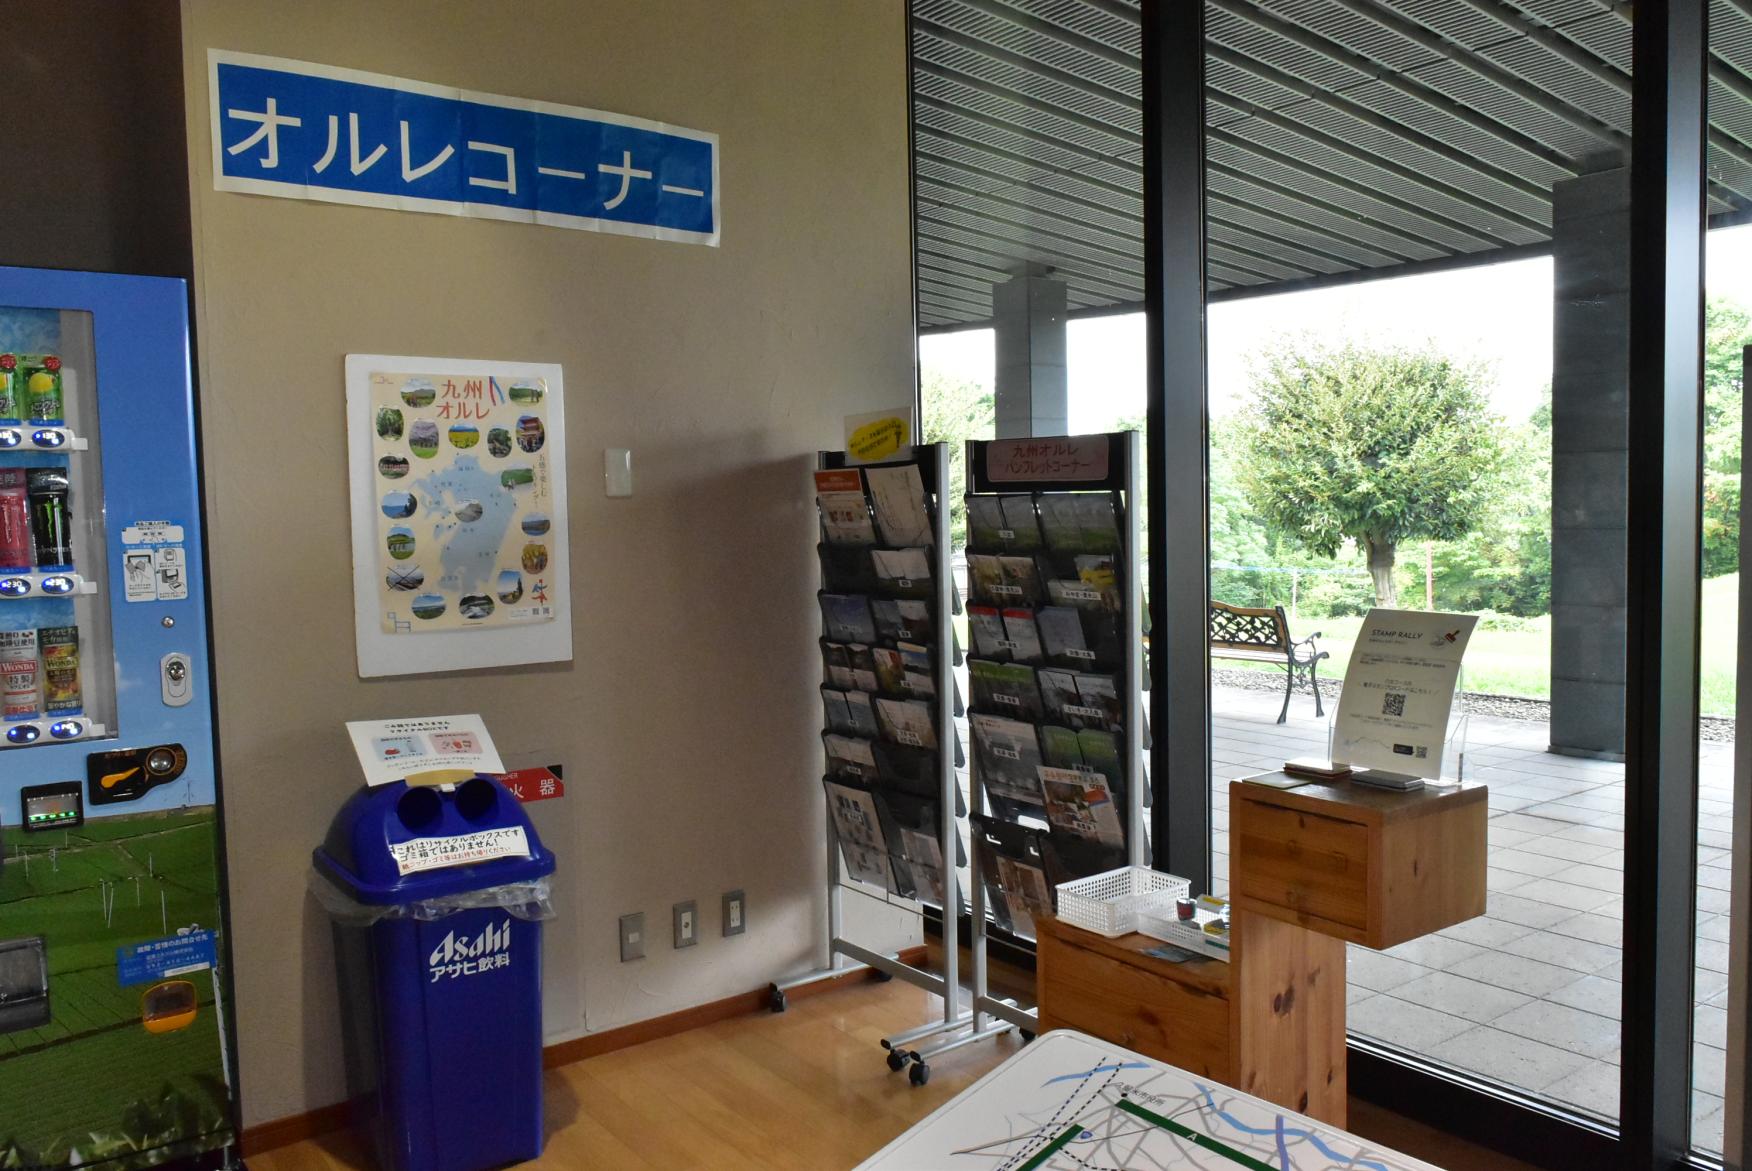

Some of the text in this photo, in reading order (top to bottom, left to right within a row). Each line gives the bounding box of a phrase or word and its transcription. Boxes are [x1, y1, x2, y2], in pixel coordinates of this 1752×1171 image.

[227, 97, 704, 211] オルレコーナー
[441, 379, 483, 400] 九州
[436, 401, 490, 420] オルレ
[1371, 629, 1424, 640] STAMP RALLY
[3, 663, 34, 673] WONDA
[509, 778, 557, 799] 火器
[429, 917, 510, 967] Asahi
[430, 951, 510, 983] アサヒ飲料
